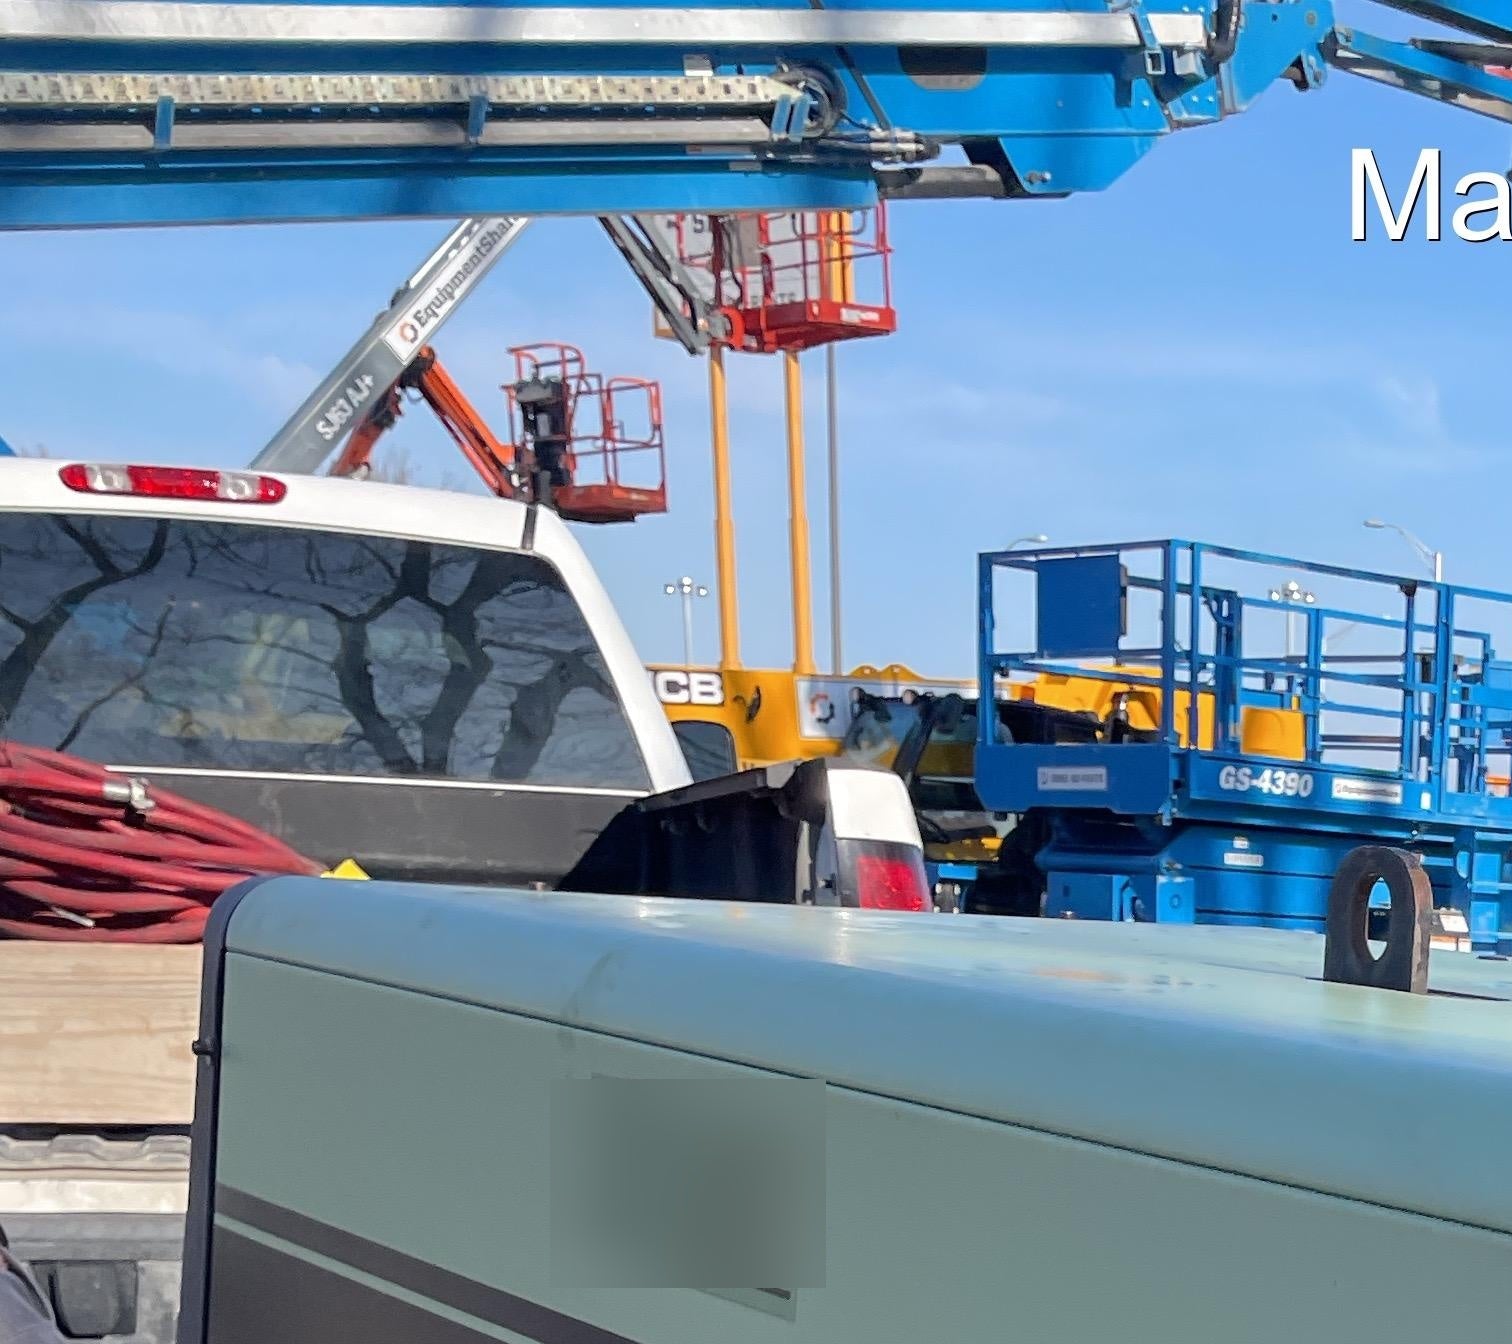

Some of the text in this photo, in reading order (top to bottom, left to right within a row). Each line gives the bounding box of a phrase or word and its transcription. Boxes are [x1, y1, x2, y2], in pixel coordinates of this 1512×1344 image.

[413, 216, 519, 329] EquipmentShar
[649, 670, 724, 705] CB
[1219, 765, 1314, 797] GS-4390
